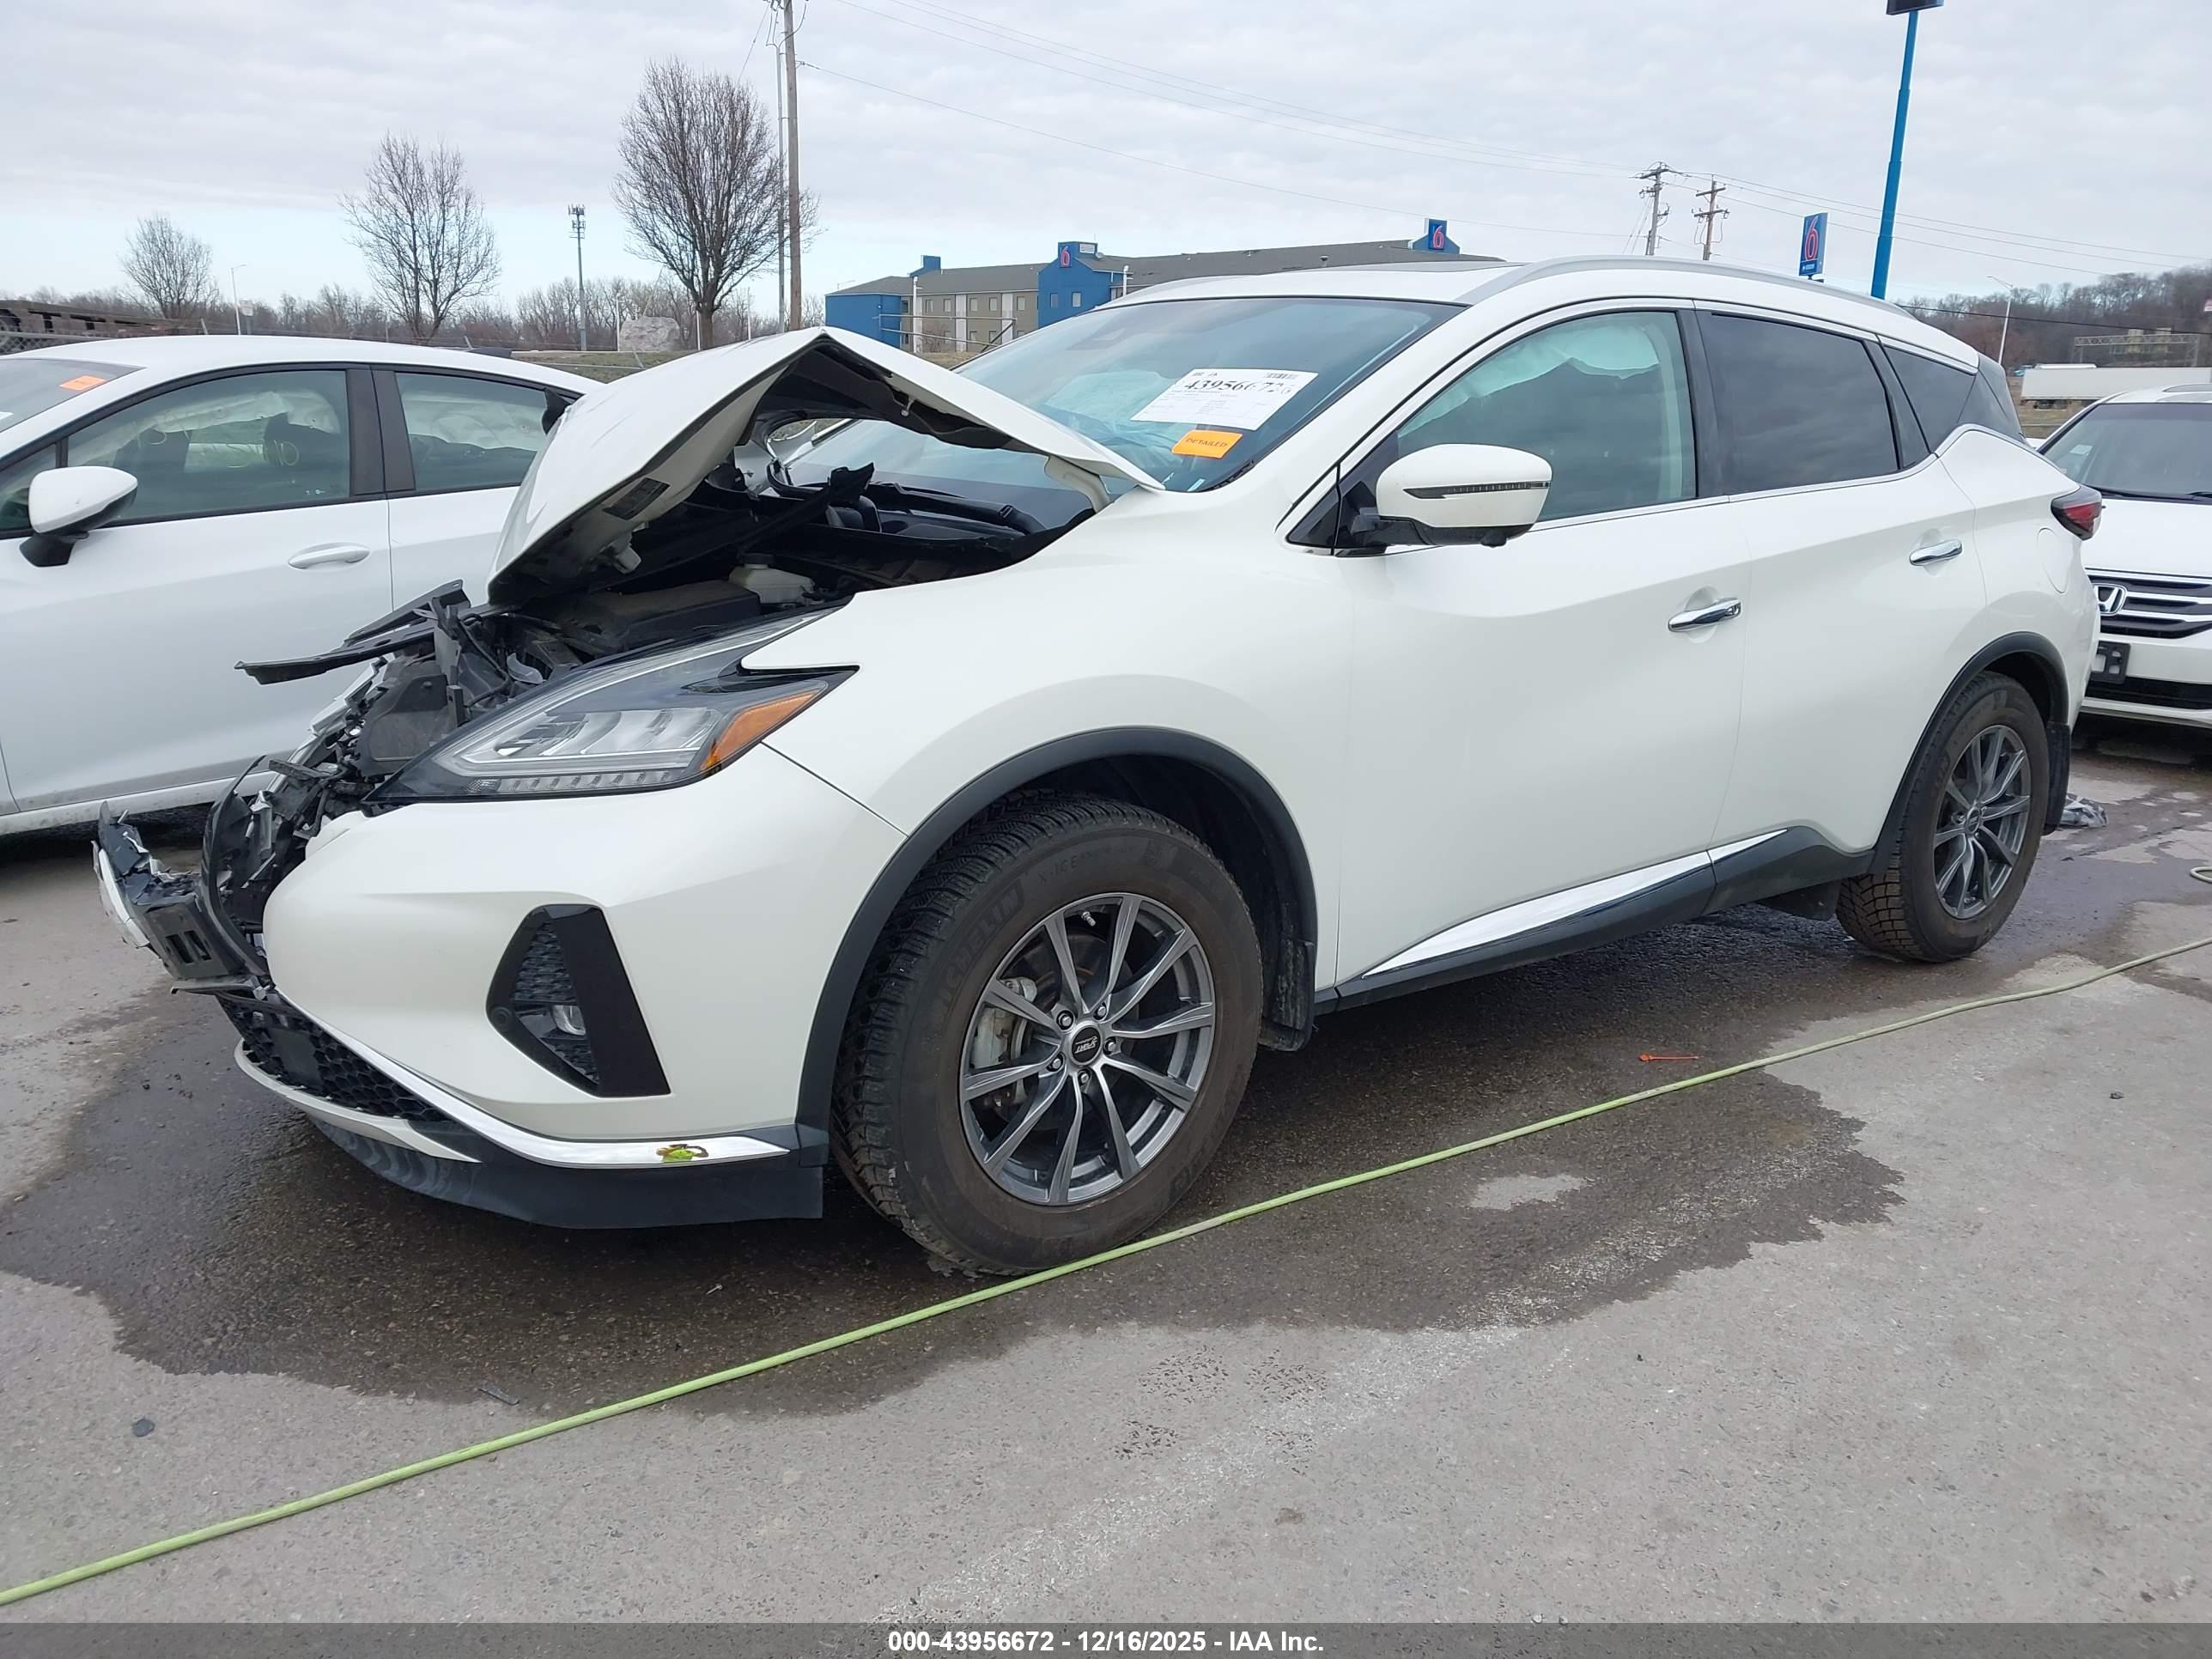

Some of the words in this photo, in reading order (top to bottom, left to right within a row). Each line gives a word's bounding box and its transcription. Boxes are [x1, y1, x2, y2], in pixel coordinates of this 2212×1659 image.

[1433, 225, 1444, 248] 6
[1805, 215, 1819, 261] 6
[1060, 246, 1070, 268] 6
